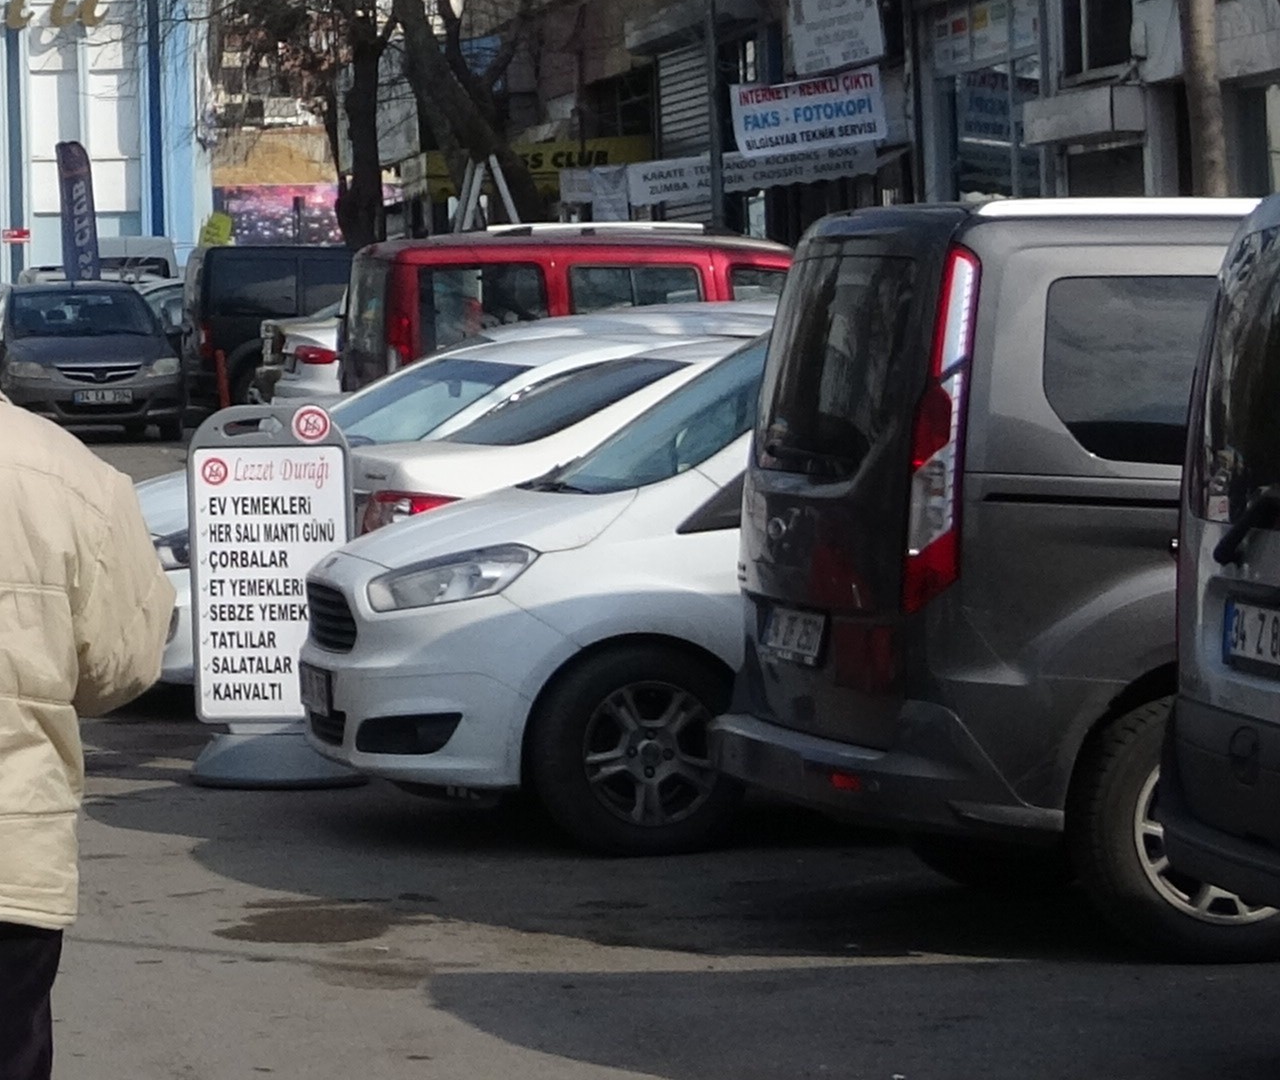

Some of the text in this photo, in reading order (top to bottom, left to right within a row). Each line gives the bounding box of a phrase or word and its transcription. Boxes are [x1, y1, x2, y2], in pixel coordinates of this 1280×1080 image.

[842, 72, 874, 95] ÇIKTI
[743, 110, 780, 132] FAKS
[552, 150, 609, 168] CLUB
[233, 456, 329, 489] Lezzet Durağı
[209, 497, 227, 516] EV
[209, 518, 335, 543] HER SALI MANTI GÜNÜ
[209, 550, 288, 573] ÇORBALAR
[209, 579, 225, 596] ET
[209, 604, 254, 621] SEBZE
[210, 631, 277, 648] TATLILAR
[212, 656, 293, 673] SALATALAR
[213, 683, 282, 701] KAHVALTI
